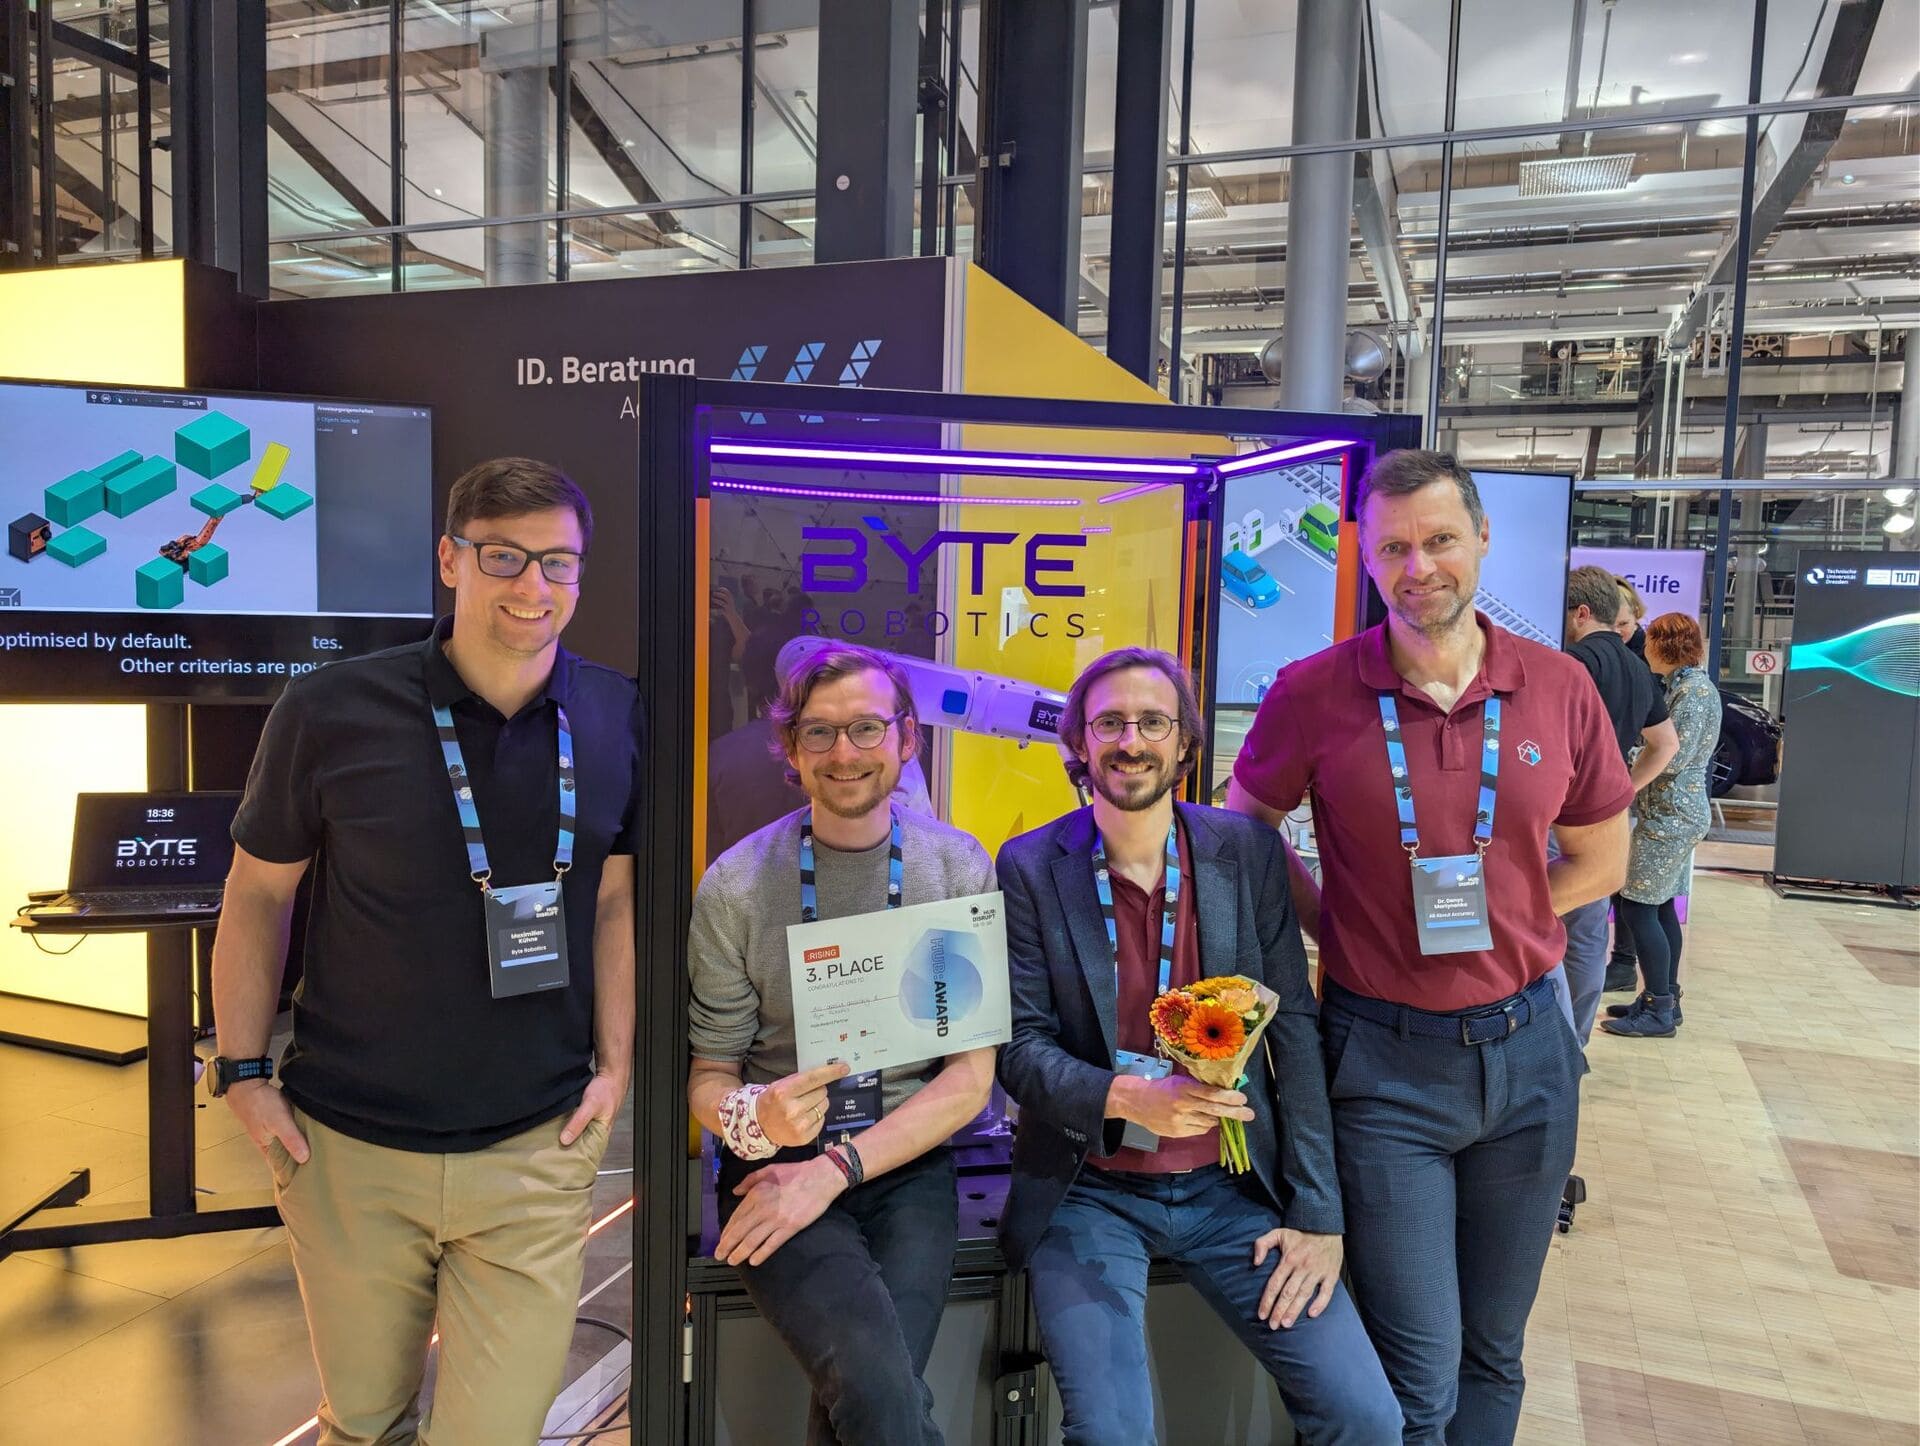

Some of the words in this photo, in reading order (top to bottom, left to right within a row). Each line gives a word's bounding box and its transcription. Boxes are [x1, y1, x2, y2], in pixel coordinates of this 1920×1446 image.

[517, 358, 553, 385] ID.
[620, 396, 640, 419] A
[802, 526, 1087, 597] BYTE
[801, 608, 1085, 637] ROBOTICS
[94, 633, 116, 651] by
[122, 633, 192, 649] default.
[313, 636, 343, 649] tes.
[120, 658, 173, 673] Other
[179, 658, 252, 674] criterias
[257, 662, 285, 674] are
[1038, 710, 1062, 722] BYT
[147, 808, 175, 818] 18:36
[118, 838, 198, 856] BYTE
[116, 858, 196, 867] ROBOTICS
[973, 914, 995, 922] DISRUPT
[806, 967, 822, 982] 3.
[828, 955, 884, 979] PLACE
